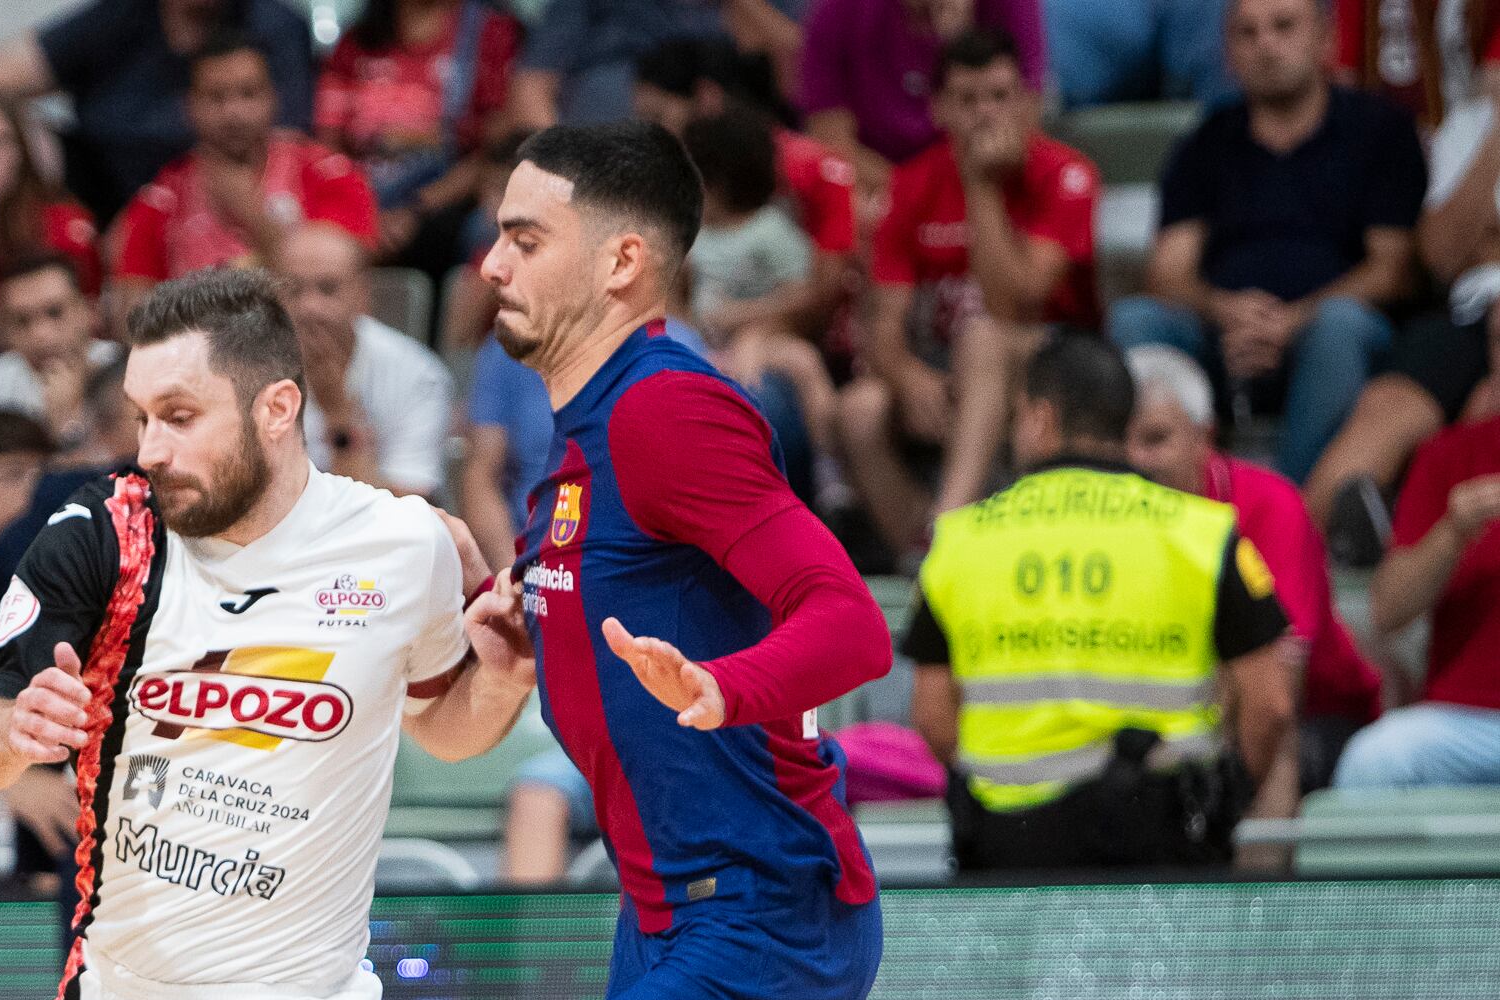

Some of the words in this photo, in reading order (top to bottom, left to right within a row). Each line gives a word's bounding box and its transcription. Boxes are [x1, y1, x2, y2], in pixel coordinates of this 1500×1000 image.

[1014, 550, 1114, 599] 010
[318, 619, 368, 628] FUTSAL
[181, 766, 273, 798] CARAVACA
[171, 799, 205, 818] AÑO
[207, 808, 272, 835] JUBILAR
[178, 783, 197, 799] DE
[200, 787, 218, 803] LA
[222, 792, 267, 815] CRUZ
[269, 803, 311, 821] 2024
[115, 816, 286, 901] Murcia
